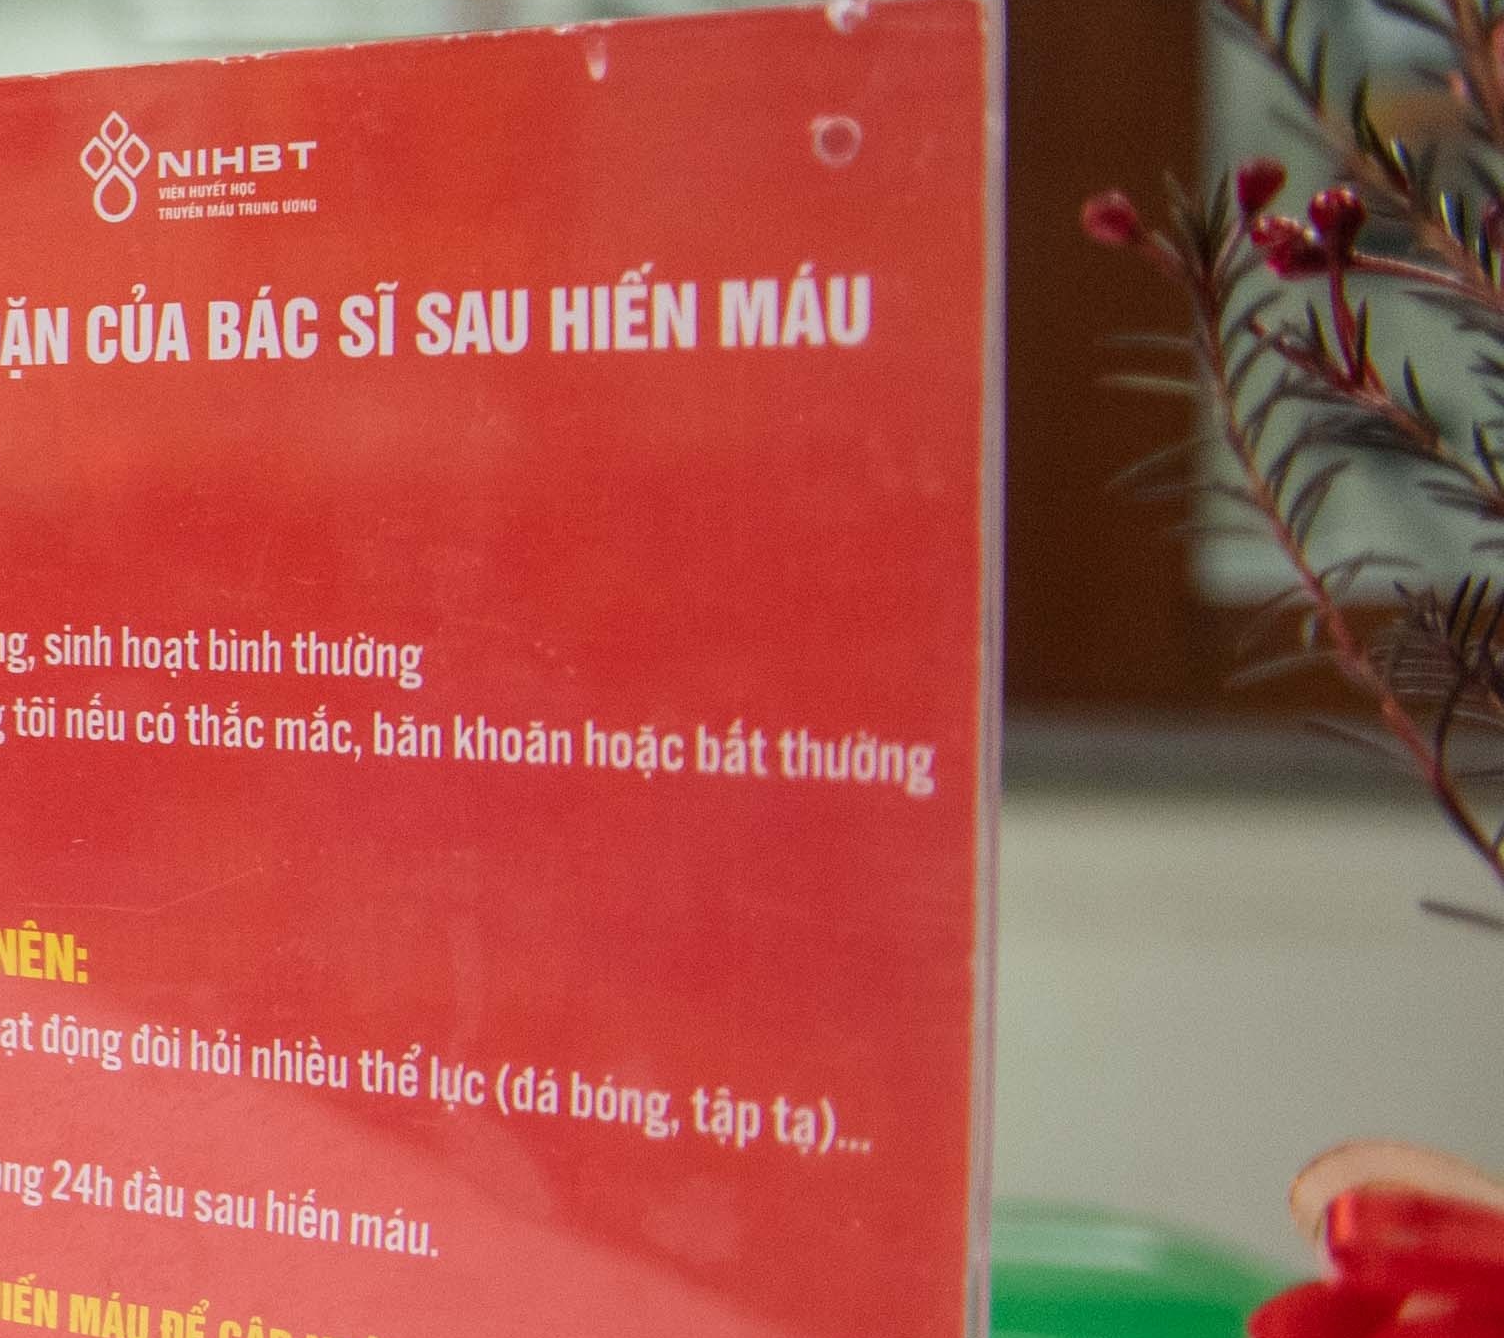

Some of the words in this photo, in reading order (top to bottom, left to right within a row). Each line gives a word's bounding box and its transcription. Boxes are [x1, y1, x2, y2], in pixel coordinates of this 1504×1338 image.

[157, 141, 317, 178] NIHBT
[88, 283, 190, 364] CỦA
[207, 287, 318, 360] BÁC
[339, 280, 399, 358] SĨ
[416, 287, 529, 356] SAU
[550, 262, 696, 352] HIẾN
[719, 262, 871, 348] MÁU
[44, 626, 112, 669] sinh
[120, 625, 199, 677] hoạt
[209, 628, 282, 674] bình
[291, 631, 424, 690] thường
[12, 696, 55, 739] tôi
[65, 692, 126, 742] nếu
[136, 701, 176, 745] có
[187, 700, 265, 751] thắc
[275, 704, 361, 762] mắc,
[373, 711, 442, 759] băn
[453, 714, 573, 766] khoăn
[585, 721, 685, 780] hoặc
[695, 718, 769, 777] bất
[777, 727, 936, 798] thường
[41, 1013, 122, 1072] động
[131, 1022, 181, 1070] đòi
[190, 1026, 241, 1078] hỏi
[251, 1035, 348, 1089] nhiều
[357, 1042, 422, 1099] thể
[430, 1054, 485, 1111] lực
[495, 1062, 559, 1117] (đá
[570, 1072, 680, 1140] bóng,
[692, 1085, 761, 1149] tập
[51, 1160, 113, 1208] 24h
[122, 1165, 185, 1220] đầu
[193, 1185, 256, 1229] sau
[265, 1188, 340, 1242] hiến
[349, 1207, 439, 1259] máu.
